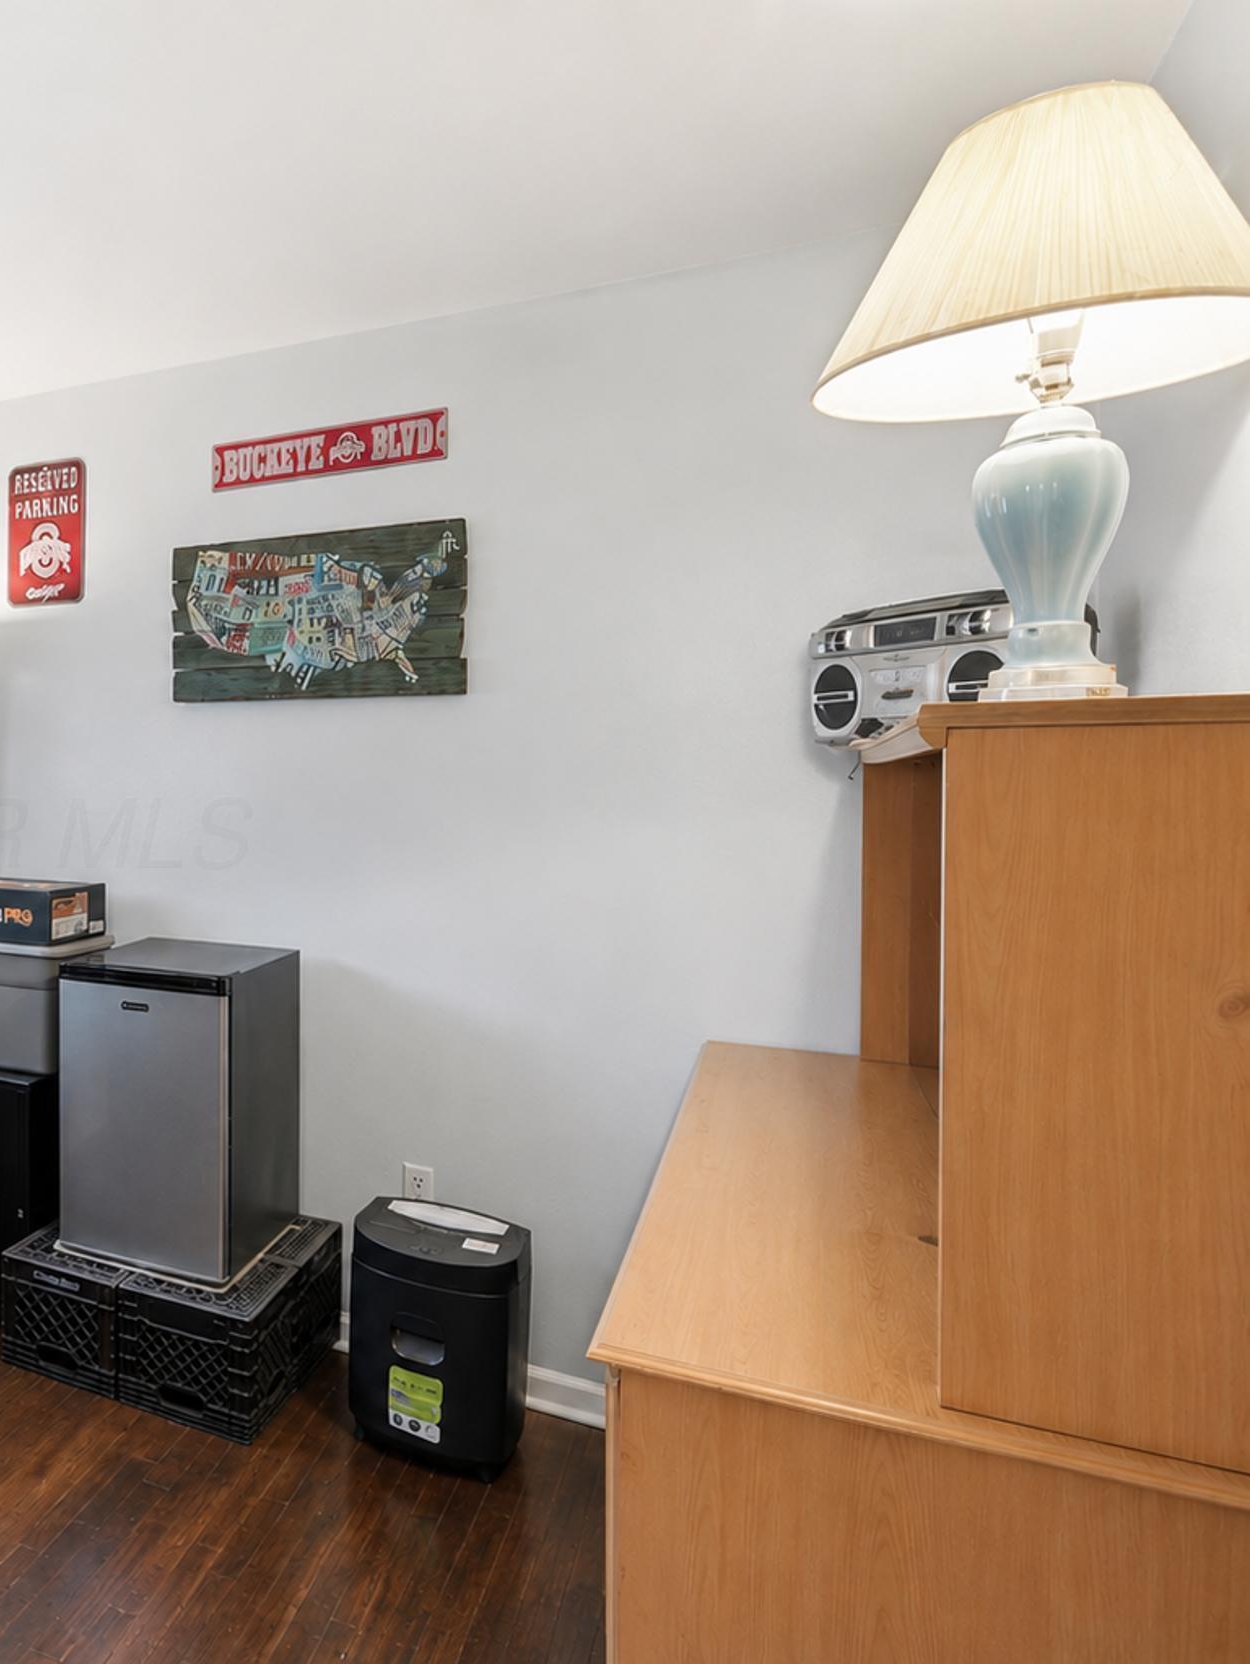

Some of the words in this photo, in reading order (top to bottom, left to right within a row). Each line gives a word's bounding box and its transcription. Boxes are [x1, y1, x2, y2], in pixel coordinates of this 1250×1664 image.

[222, 434, 326, 483] BUCKEYE
[14, 467, 78, 495] RESERVED
[14, 494, 79, 520] PARKING
[3, 907, 34, 927] PRO
